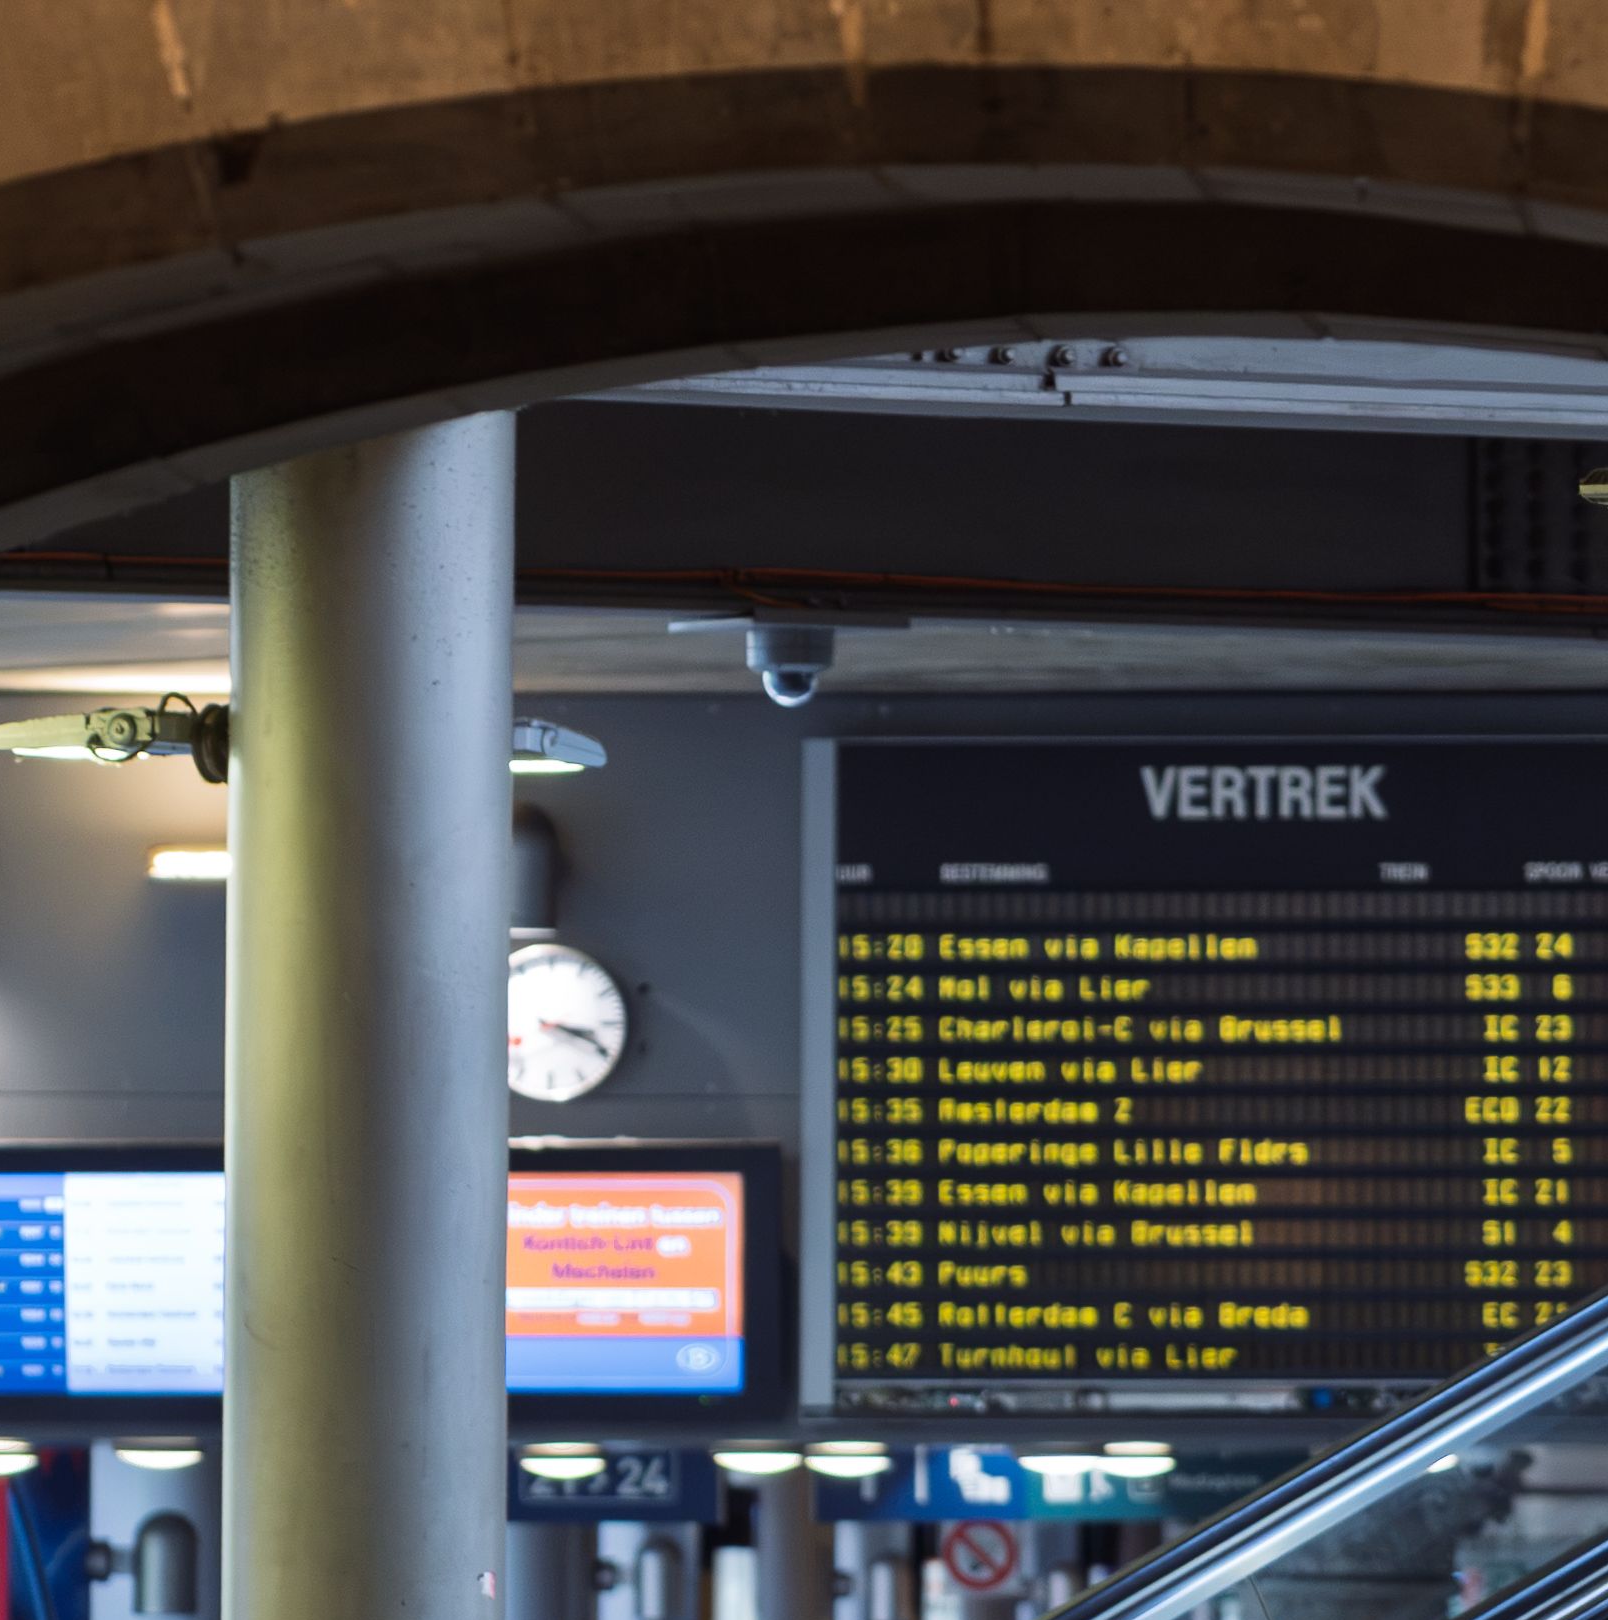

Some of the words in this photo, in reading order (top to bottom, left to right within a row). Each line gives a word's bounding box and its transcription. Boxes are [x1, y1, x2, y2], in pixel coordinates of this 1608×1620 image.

[1141, 764, 1387, 819] VERTREK
[838, 933, 925, 961] 15:20
[937, 932, 1030, 961] Essen
[1043, 934, 1100, 961] via
[1113, 933, 1259, 962] Kapellen
[1463, 930, 1521, 962] S32
[1534, 930, 1575, 961] 24
[838, 974, 924, 1002] 15:24
[937, 974, 991, 1002] Mol
[1008, 975, 1065, 1002] via
[1078, 975, 1151, 1002] Lier
[838, 1014, 924, 1042] 15:25
[937, 1014, 1133, 1043] Charleroi-C
[1147, 1016, 1205, 1043] via
[1217, 1013, 1343, 1043] Brussel
[1482, 1012, 1521, 1043] IC
[1534, 1012, 1575, 1042] 23
[838, 1055, 925, 1084] 15:30
[936, 1055, 1047, 1085] Leuven
[1058, 1056, 1119, 1084] via
[1129, 1055, 1204, 1084] Lier
[1483, 1054, 1521, 1084] IC
[1537, 1054, 1573, 1084] 12
[837, 1096, 924, 1124] 15:35
[936, 1096, 1100, 1125] Amsterdam
[1534, 1094, 1572, 1125] 22
[1111, 1137, 1205, 1166] Lille
[1482, 1136, 1520, 1166] IC
[1551, 1136, 1574, 1166] 5
[936, 1177, 1030, 1207] Essen
[1041, 1179, 1100, 1207] via
[1111, 1178, 1259, 1208] Kapellen
[1482, 1177, 1520, 1207] IC
[1534, 1177, 1571, 1207] 21
[936, 1219, 1043, 1249] Nijvel
[1059, 1220, 1118, 1247] via
[1129, 1218, 1255, 1248] Brussel
[1551, 1218, 1575, 1246] 4
[936, 1259, 1029, 1288] Puurs
[1533, 1259, 1574, 1288] 23
[936, 1300, 1100, 1330] Rotterdam
[1112, 1300, 1134, 1329] C
[1146, 1302, 1205, 1330] via
[1216, 1300, 1312, 1330] Breda
[1480, 1300, 1520, 1329] EC
[937, 1341, 1078, 1369] Turnhout
[1095, 1343, 1152, 1370] via
[1164, 1342, 1239, 1369] Lier
